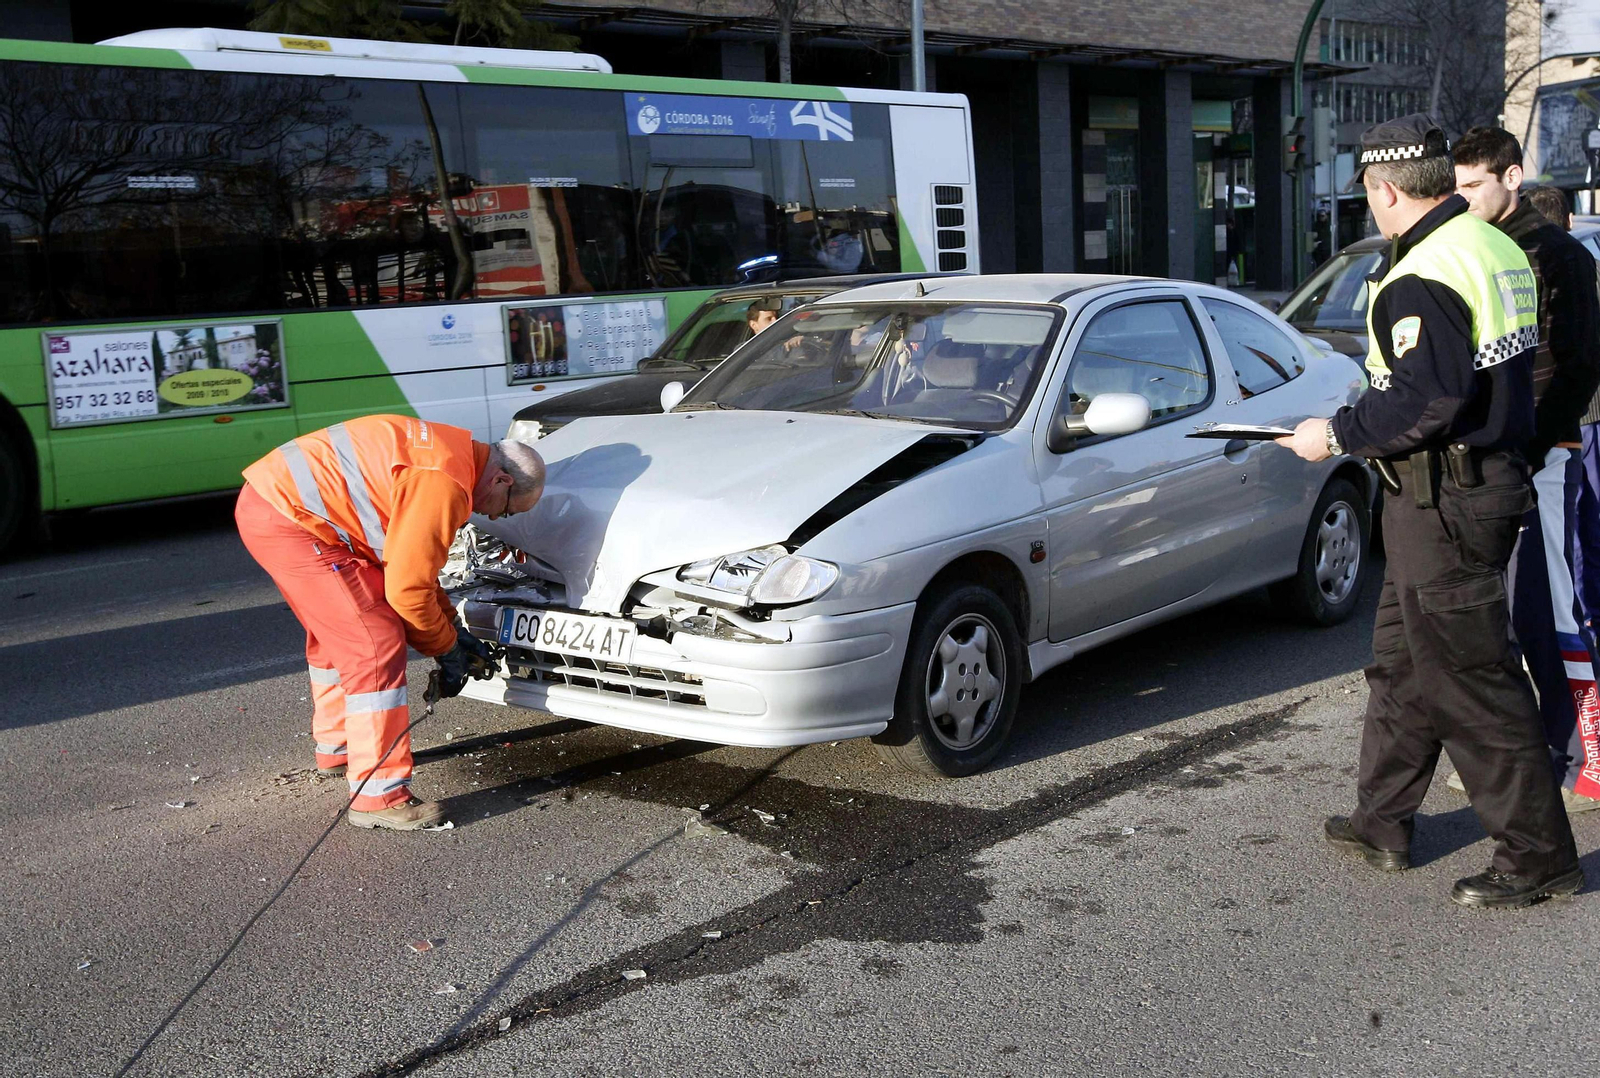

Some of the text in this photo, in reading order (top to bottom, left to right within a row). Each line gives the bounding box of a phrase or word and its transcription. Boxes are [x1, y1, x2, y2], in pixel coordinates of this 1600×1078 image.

[665, 111, 734, 126] CÓRDOBA 2016
[583, 307, 652, 321] Banquetes
[587, 323, 653, 336] Celebraciones
[104, 341, 149, 352] salones
[587, 337, 653, 351] Reuniones de
[53, 348, 152, 378] azahara
[170, 377, 242, 390] Ofertas especiales
[55, 389, 155, 410] 957 32 32 68
[186, 391, 205, 400] 2009
[211, 388, 229, 398] 2010
[503, 629, 509, 638] E
[514, 612, 630, 657] CO 8424 AT
